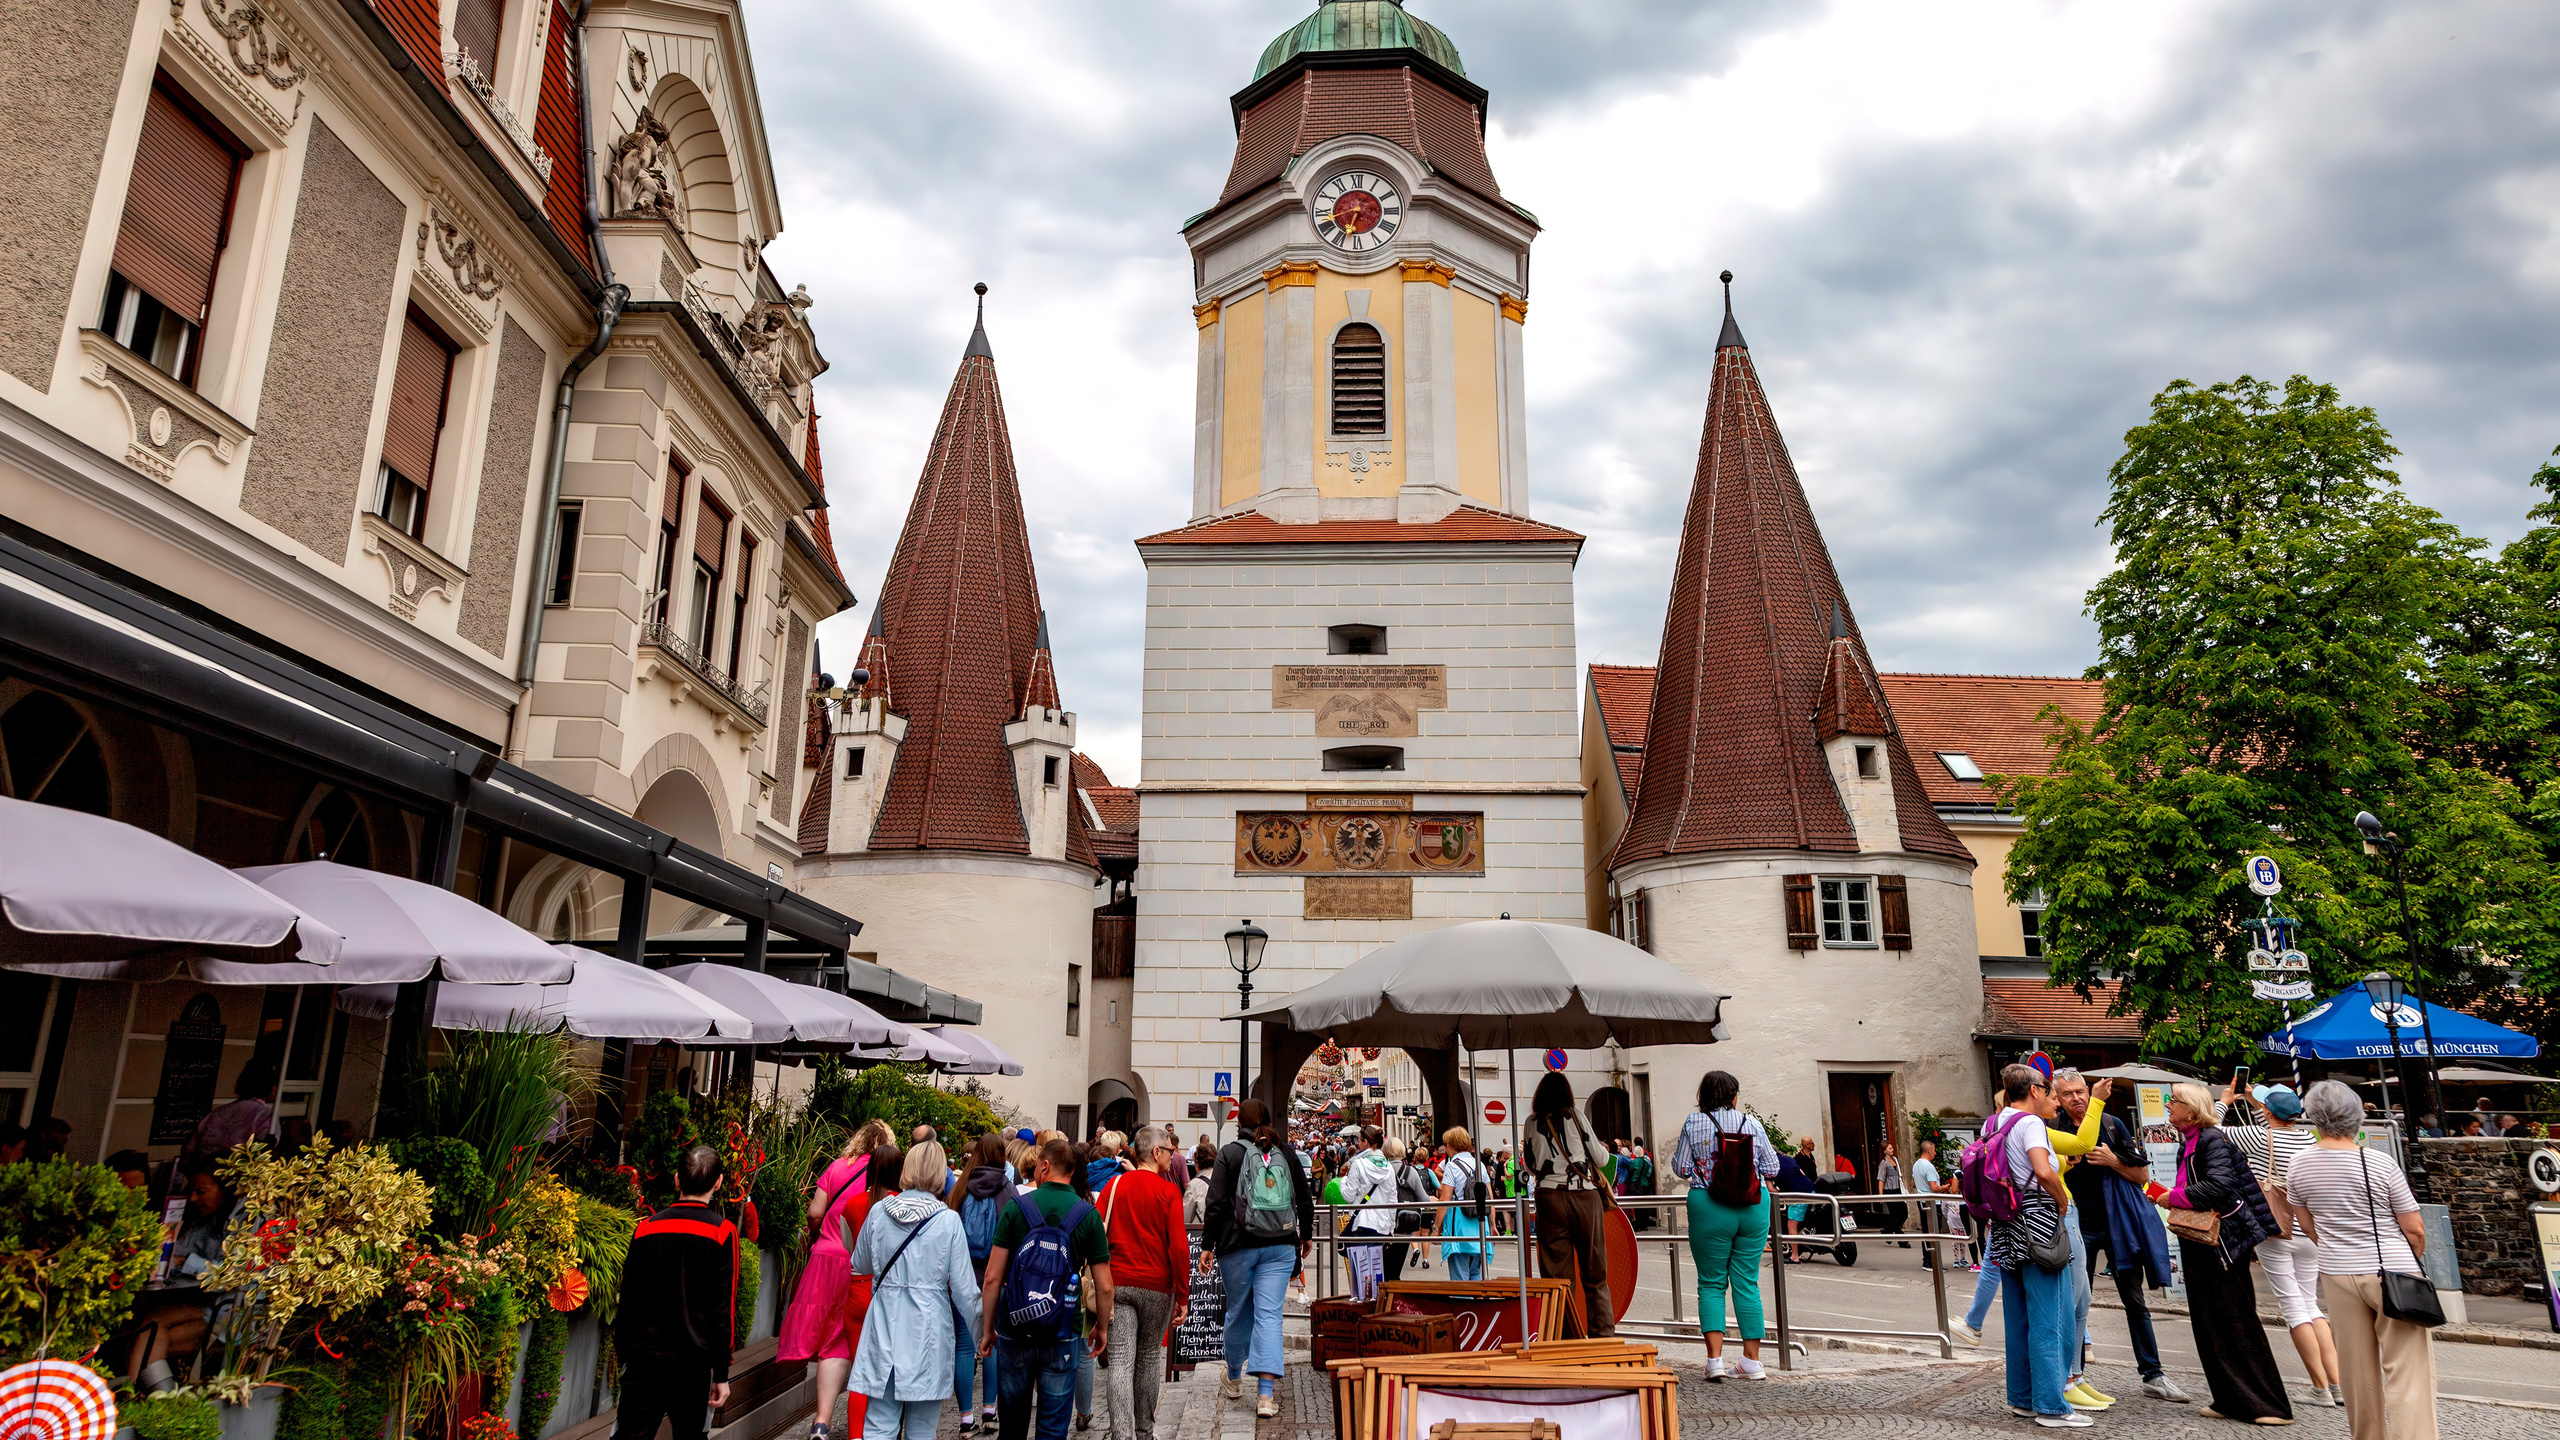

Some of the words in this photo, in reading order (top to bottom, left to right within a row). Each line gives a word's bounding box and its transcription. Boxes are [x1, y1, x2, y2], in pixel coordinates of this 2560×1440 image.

[1350, 175, 1364, 189] XII
[1384, 206, 1399, 215] III
[2259, 871, 2274, 882] HB
[2263, 984, 2307, 996] BIERGARTEN
[2275, 1041, 2301, 1055] MÜNCEN
[2356, 1043, 2414, 1055] HOFBÄU
[2434, 1042, 2500, 1055] MÜNCHEN
[1188, 1289, 1226, 1300] arillen-
[1010, 1298, 1052, 1326] PUMA
[1315, 1309, 1361, 1325] JAMESO
[1361, 1328, 1420, 1349] JAMESON
